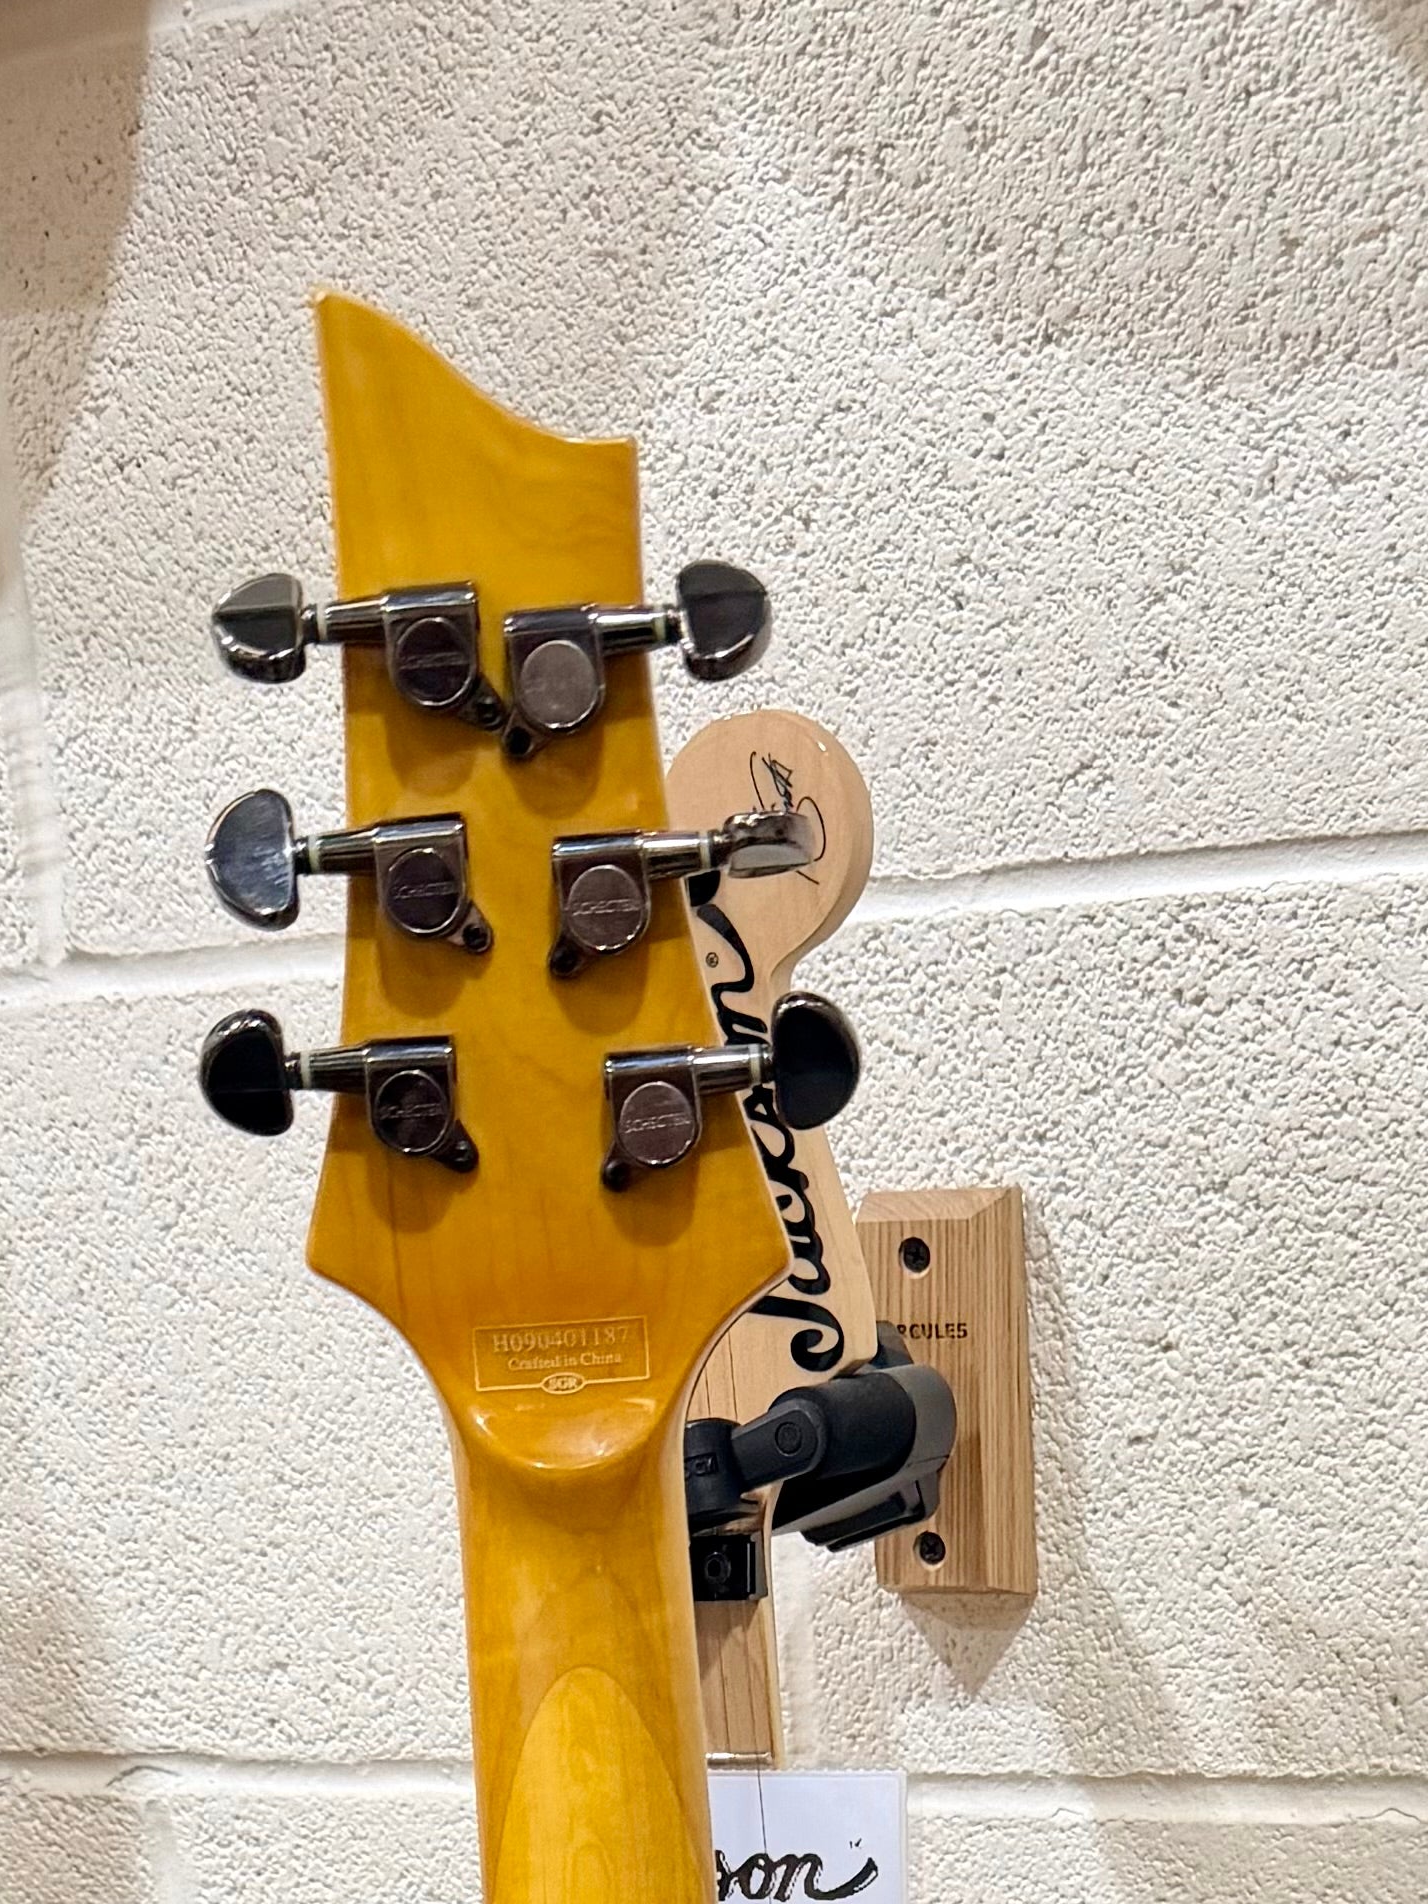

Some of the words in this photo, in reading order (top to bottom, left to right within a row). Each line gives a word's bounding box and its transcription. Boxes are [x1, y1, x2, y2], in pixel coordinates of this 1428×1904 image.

[696, 904, 844, 1372] Jacksn
[897, 1323, 968, 1340] RCULES
[563, 1354, 577, 1367] in
[580, 1352, 622, 1367] China
